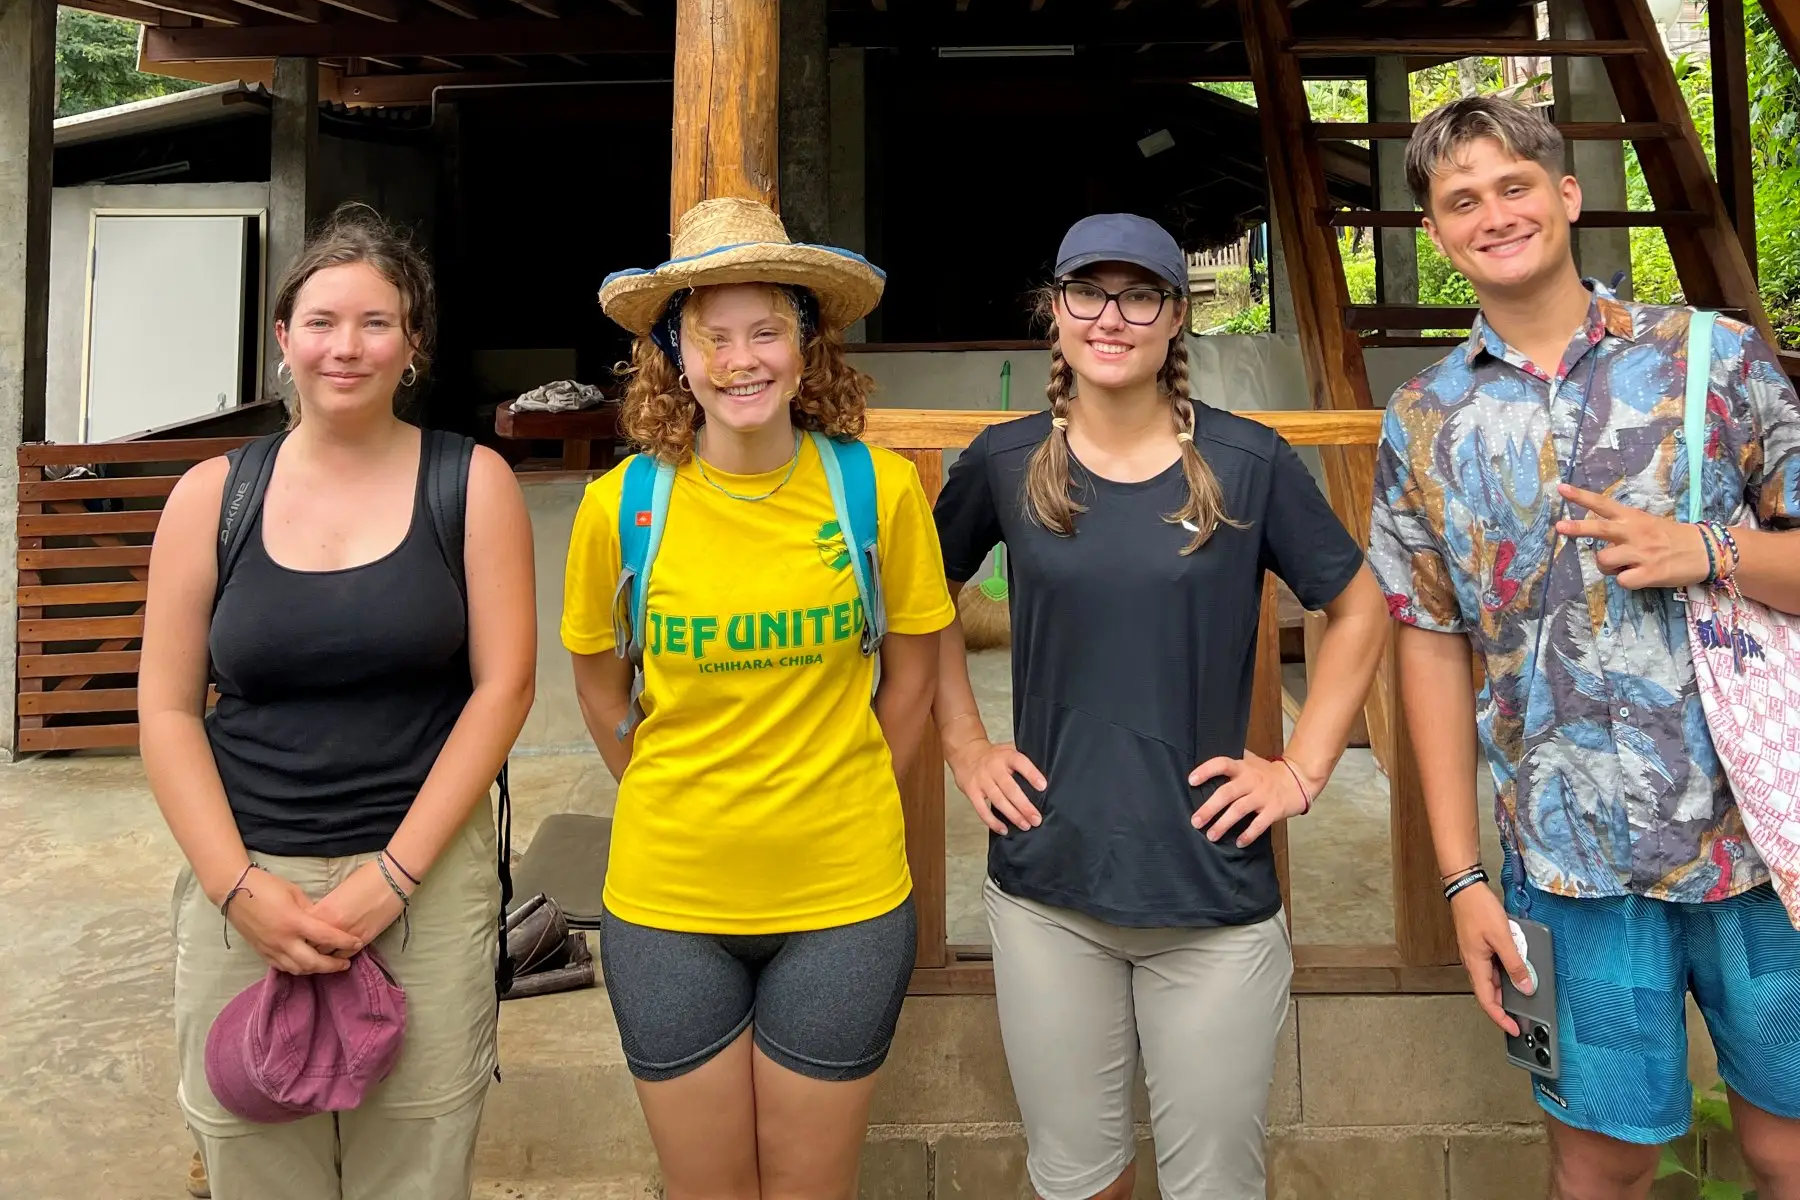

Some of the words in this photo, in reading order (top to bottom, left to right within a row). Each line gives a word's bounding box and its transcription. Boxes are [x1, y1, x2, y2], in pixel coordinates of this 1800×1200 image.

[221, 481, 250, 546] DAKINE
[649, 611, 718, 660] JEF
[726, 597, 864, 653] UNITED
[699, 659, 773, 673] ICHIHARA
[779, 653, 823, 667] CHIBA
